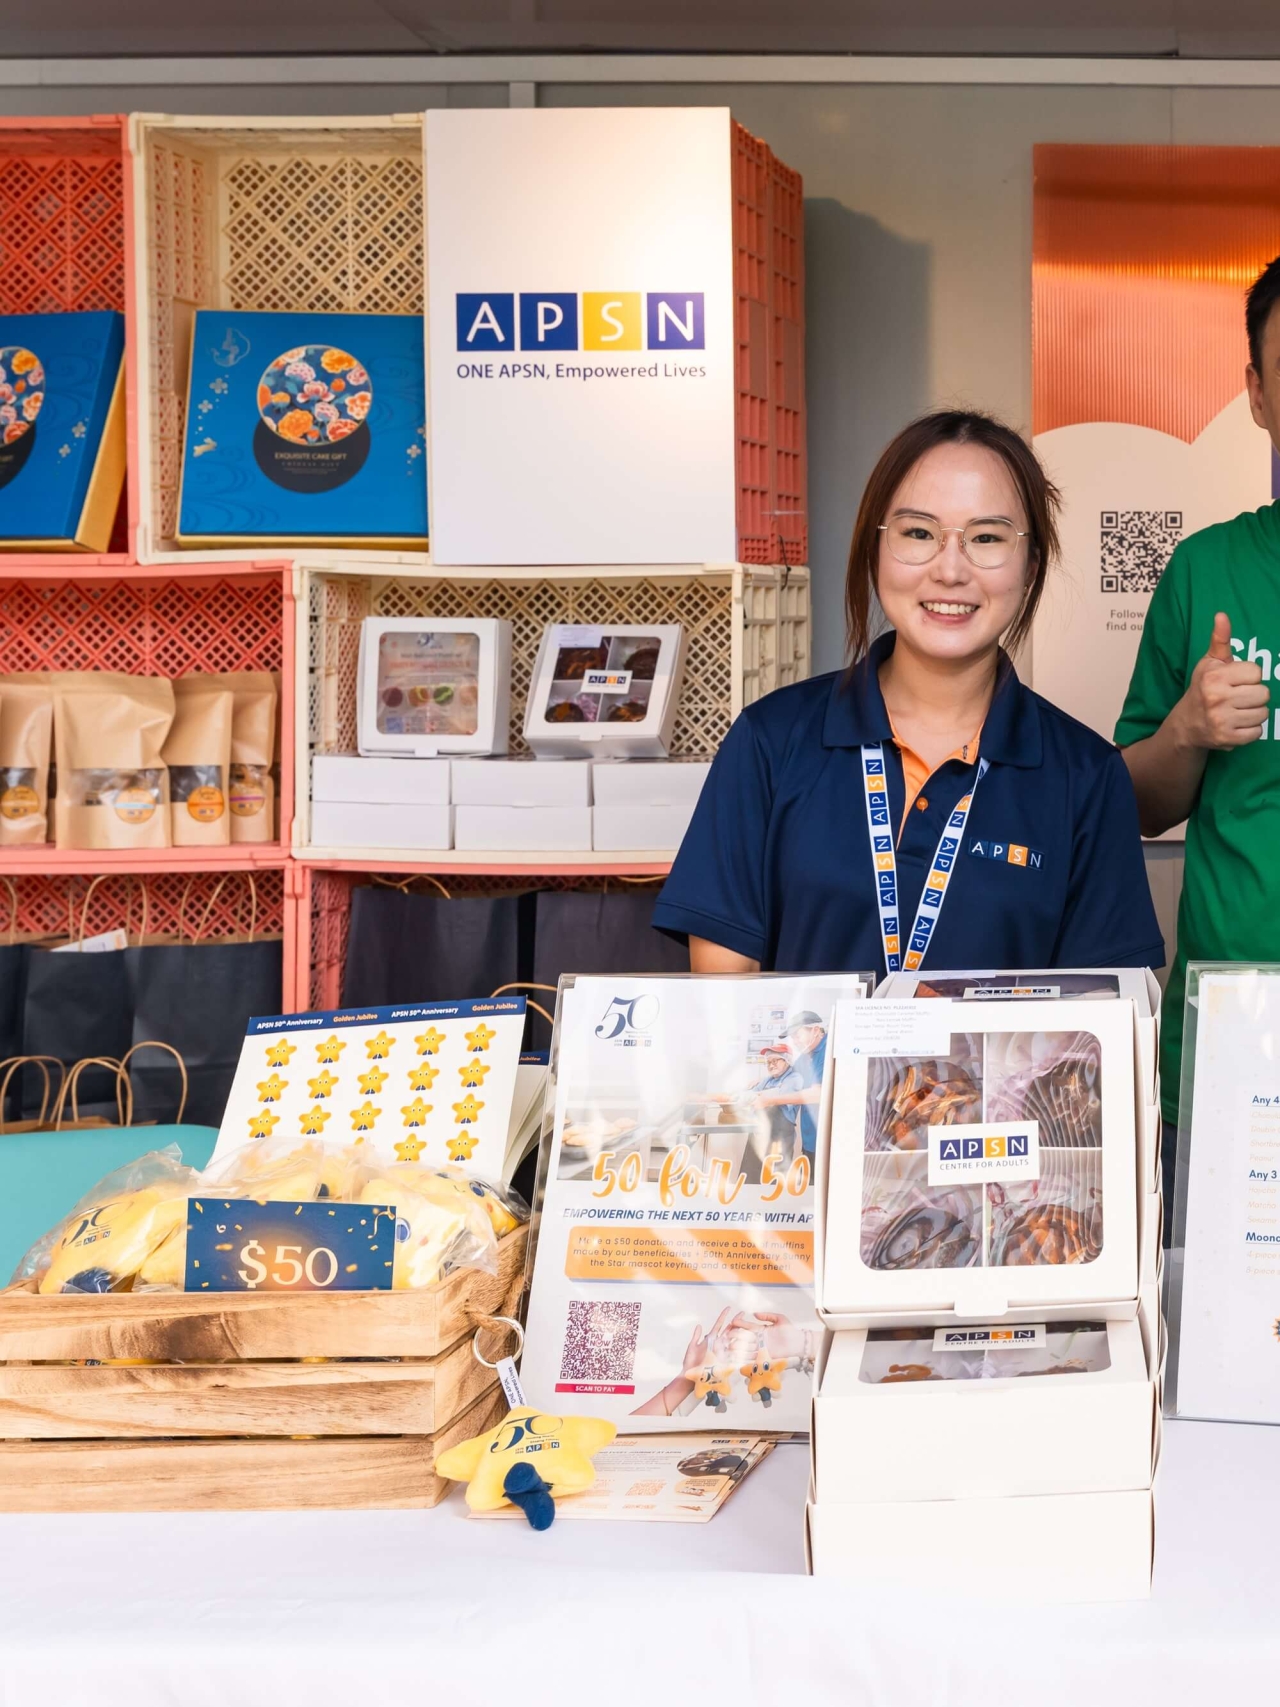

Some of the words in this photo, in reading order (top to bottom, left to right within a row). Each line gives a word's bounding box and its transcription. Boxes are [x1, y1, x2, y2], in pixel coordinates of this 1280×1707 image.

[464, 299, 696, 345] APSN
[456, 363, 494, 379] ONE
[499, 363, 551, 380] APSN,
[555, 362, 658, 381] Empowered
[663, 362, 707, 378] Lives
[1110, 609, 1145, 619] Follow
[1106, 621, 1127, 631] find
[1130, 623, 1144, 631] ou
[971, 840, 1042, 869] APSN
[875, 837, 896, 904] APSN
[925, 840, 955, 906] APSN
[421, 1007, 459, 1015] Anniversary
[472, 1004, 495, 1012] Golden
[257, 1021, 274, 1030] APSN
[286, 1018, 324, 1027] Anniversary
[333, 1015, 356, 1023] Golden
[356, 1013, 378, 1021] Jubilee
[1251, 1095, 1272, 1106] Any
[1273, 1095, 1280, 1105] 4
[942, 1136, 1026, 1159] APSN
[939, 1162, 973, 1171] CENTRE
[975, 1161, 993, 1169] FOR
[995, 1158, 1030, 1168] ADULTS
[592, 1150, 643, 1199] 50
[658, 1143, 748, 1208] for
[759, 1152, 811, 1203] 50
[1248, 1169, 1269, 1181] Any
[1270, 1170, 1278, 1180] 3
[562, 1208, 645, 1220] EMPOWERING
[647, 1210, 670, 1220] THE
[671, 1211, 703, 1221] NEXT
[704, 1211, 721, 1221] 50
[723, 1212, 762, 1222] YEARS
[764, 1212, 796, 1223] WITH
[797, 1213, 814, 1223] AP
[613, 1237, 631, 1246] $50
[633, 1237, 674, 1246] donation
[696, 1240, 730, 1248] receive
[771, 1241, 805, 1250] muffins
[602, 1248, 613, 1257] by
[632, 1249, 691, 1258] beneficiaries
[703, 1250, 723, 1258] 50th
[726, 1251, 780, 1261] Anniversary
[783, 1252, 811, 1262] Sunny
[237, 1239, 339, 1289] $50
[590, 1259, 605, 1267] the
[607, 1259, 626, 1267] Star
[628, 1260, 662, 1268] mascot
[665, 1260, 698, 1271] keyring
[730, 1262, 760, 1270] sticker
[948, 1330, 1032, 1341] APSN
[589, 1340, 611, 1348] NOW
[508, 1391, 517, 1404] ONE
